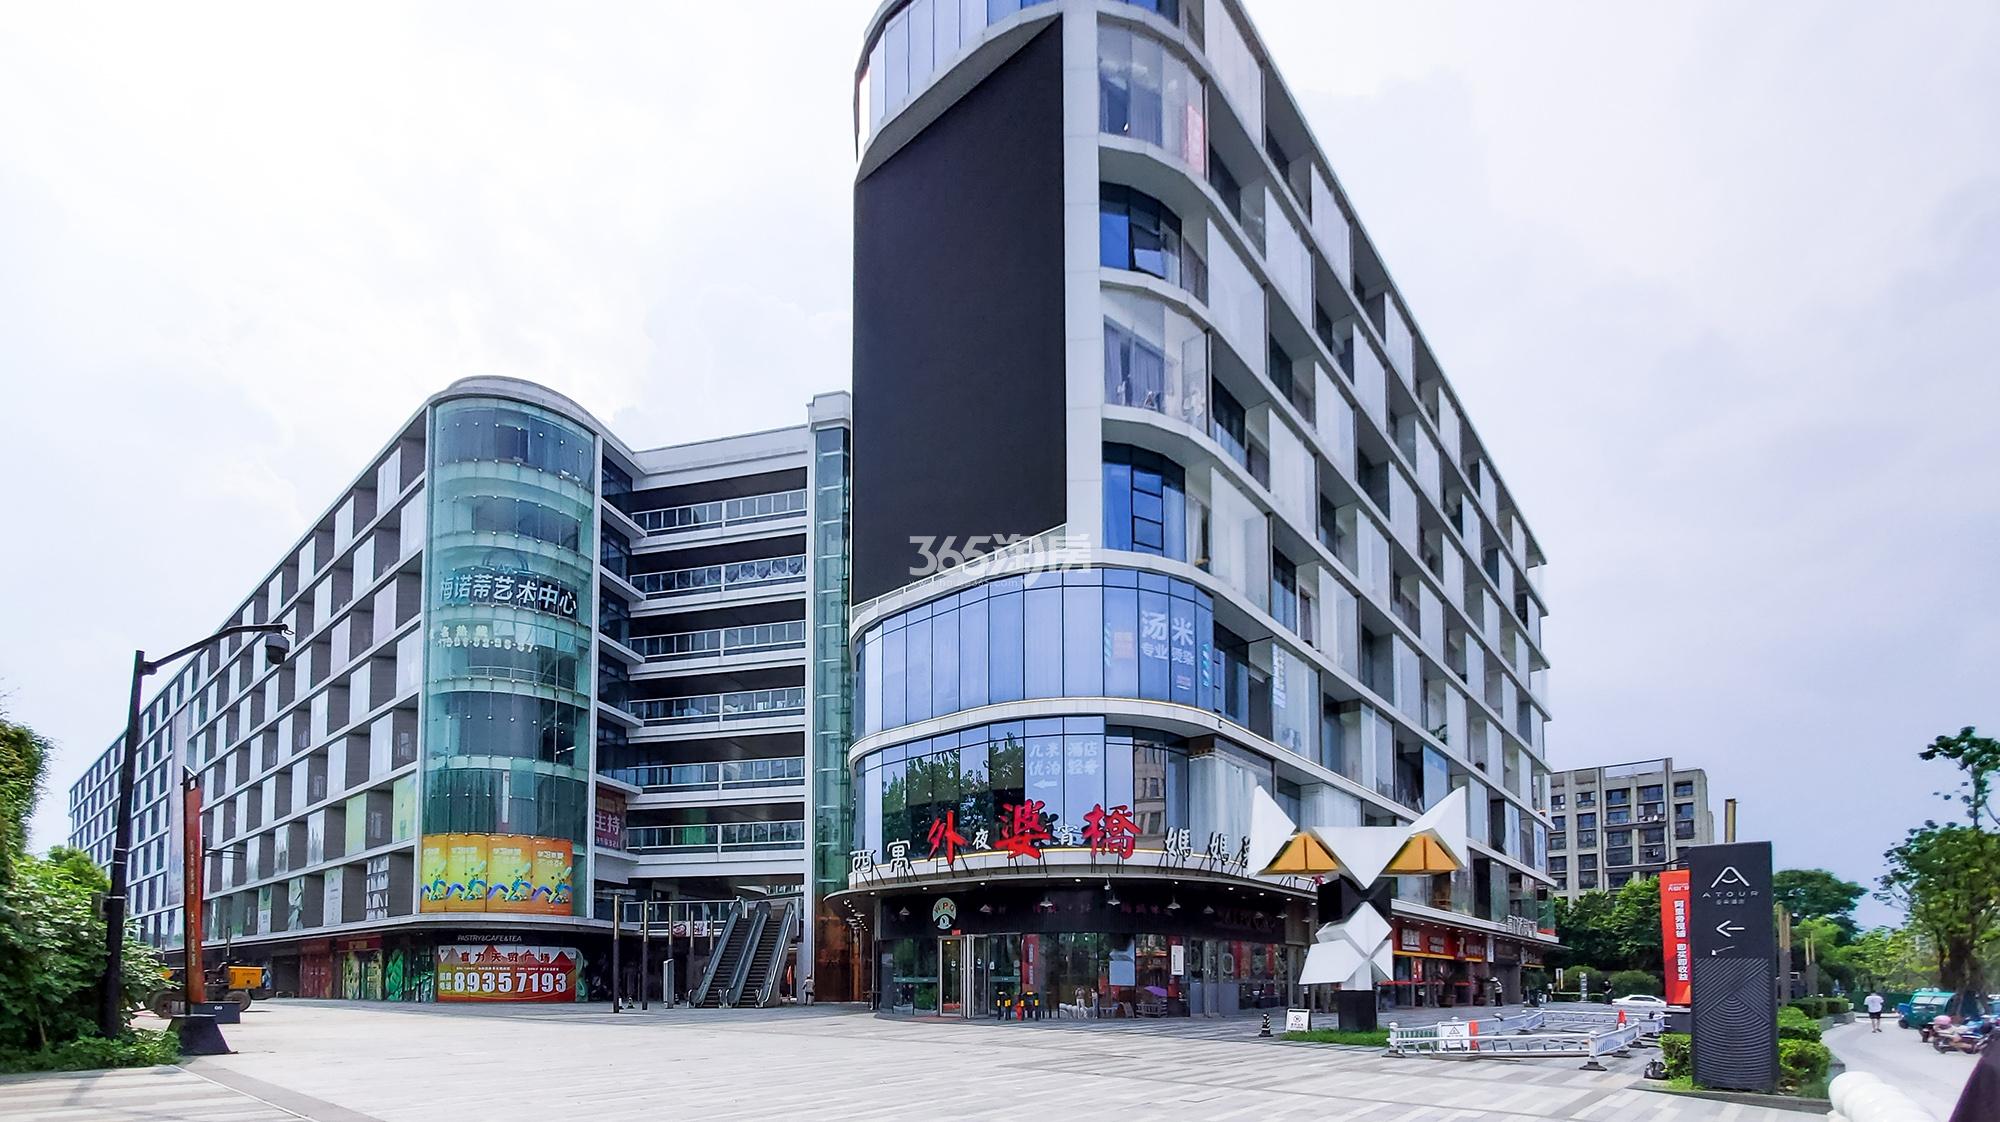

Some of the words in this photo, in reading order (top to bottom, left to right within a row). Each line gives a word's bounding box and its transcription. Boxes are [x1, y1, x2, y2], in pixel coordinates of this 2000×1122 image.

[1141, 610, 1194, 645] 汤米
[1702, 890, 1759, 898] ATOUR
[454, 972, 567, 993] 89357193
